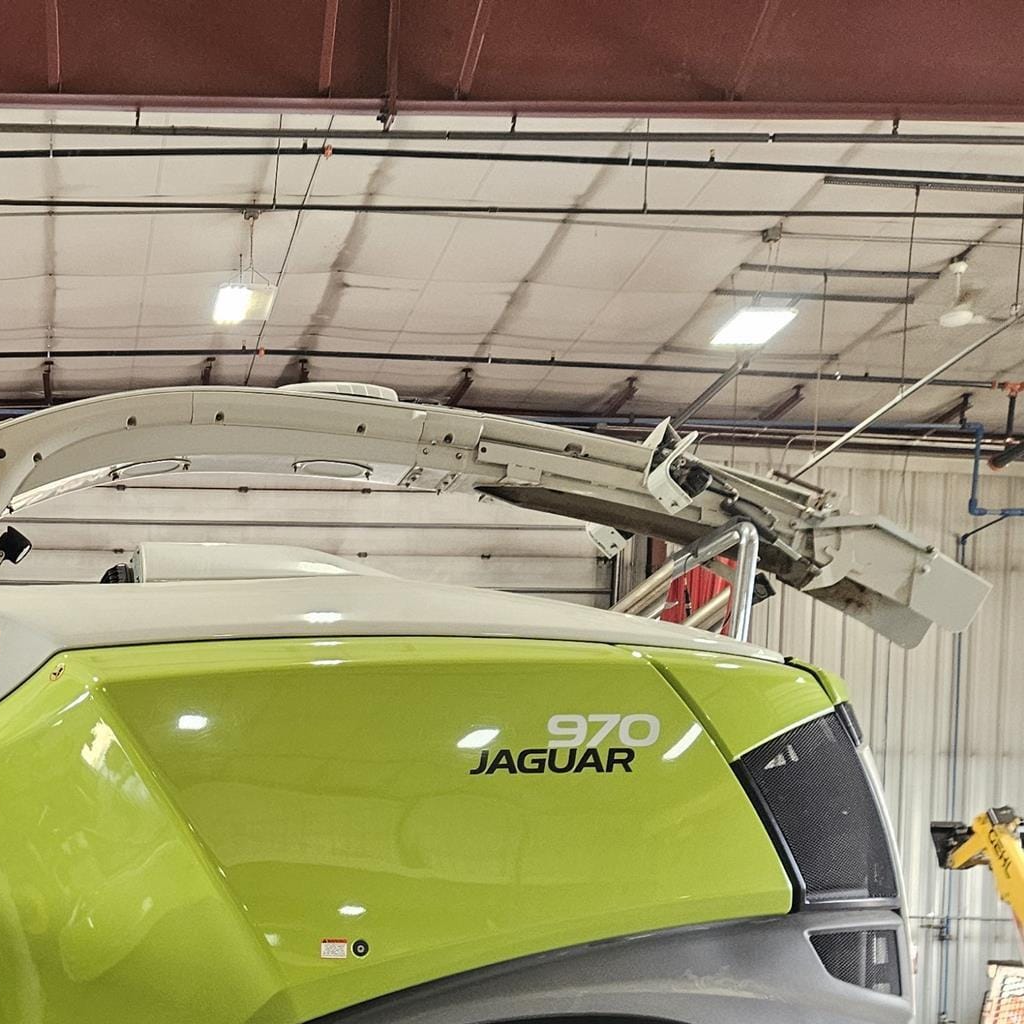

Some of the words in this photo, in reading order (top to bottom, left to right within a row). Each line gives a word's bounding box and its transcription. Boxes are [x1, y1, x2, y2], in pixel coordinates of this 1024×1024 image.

[547, 713, 661, 748] 970
[469, 747, 636, 775] JAGUAR
[988, 829, 1012, 879] GEHL
